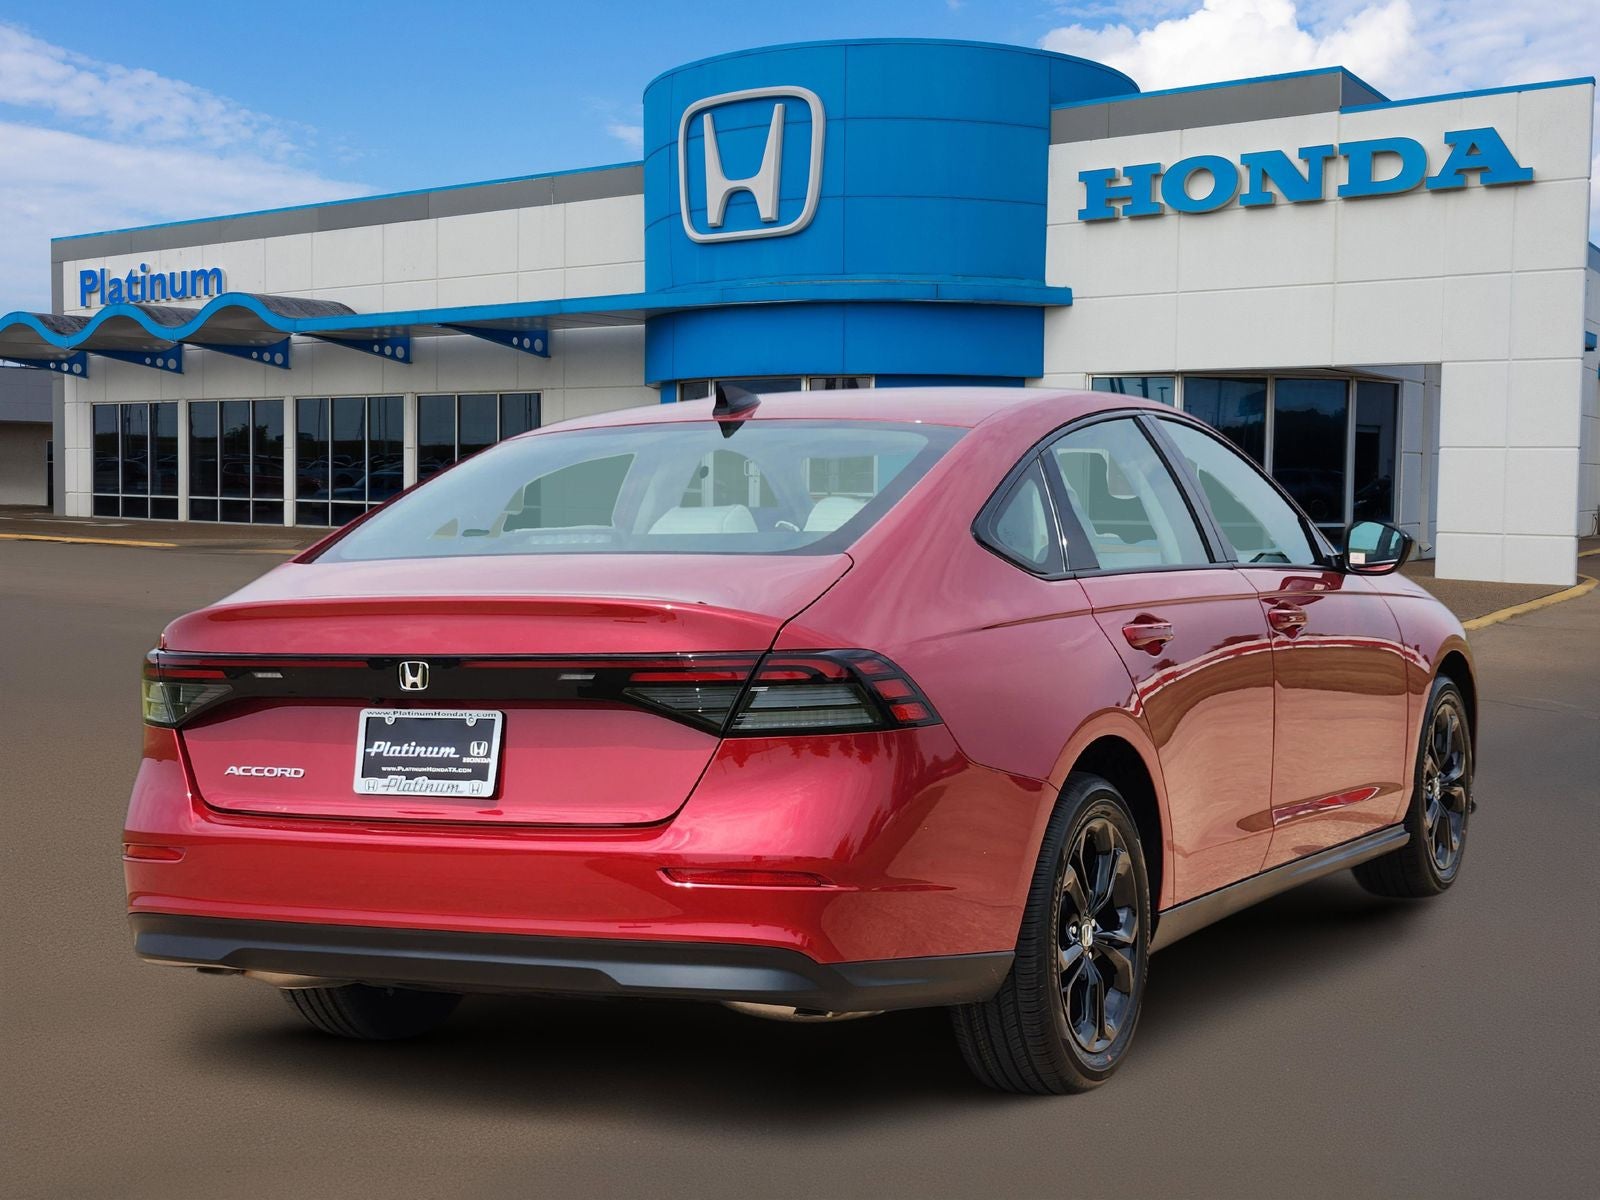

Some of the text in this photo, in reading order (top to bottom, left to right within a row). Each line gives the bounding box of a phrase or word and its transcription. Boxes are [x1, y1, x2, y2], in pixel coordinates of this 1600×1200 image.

[1077, 126, 1534, 221] HONDA
[79, 262, 224, 307] Platinum
[366, 710, 497, 718] www.PlatinumHondatx.com
[365, 741, 460, 758] Platinum
[224, 765, 305, 778] ACCORD
[381, 777, 465, 793] Platinum
